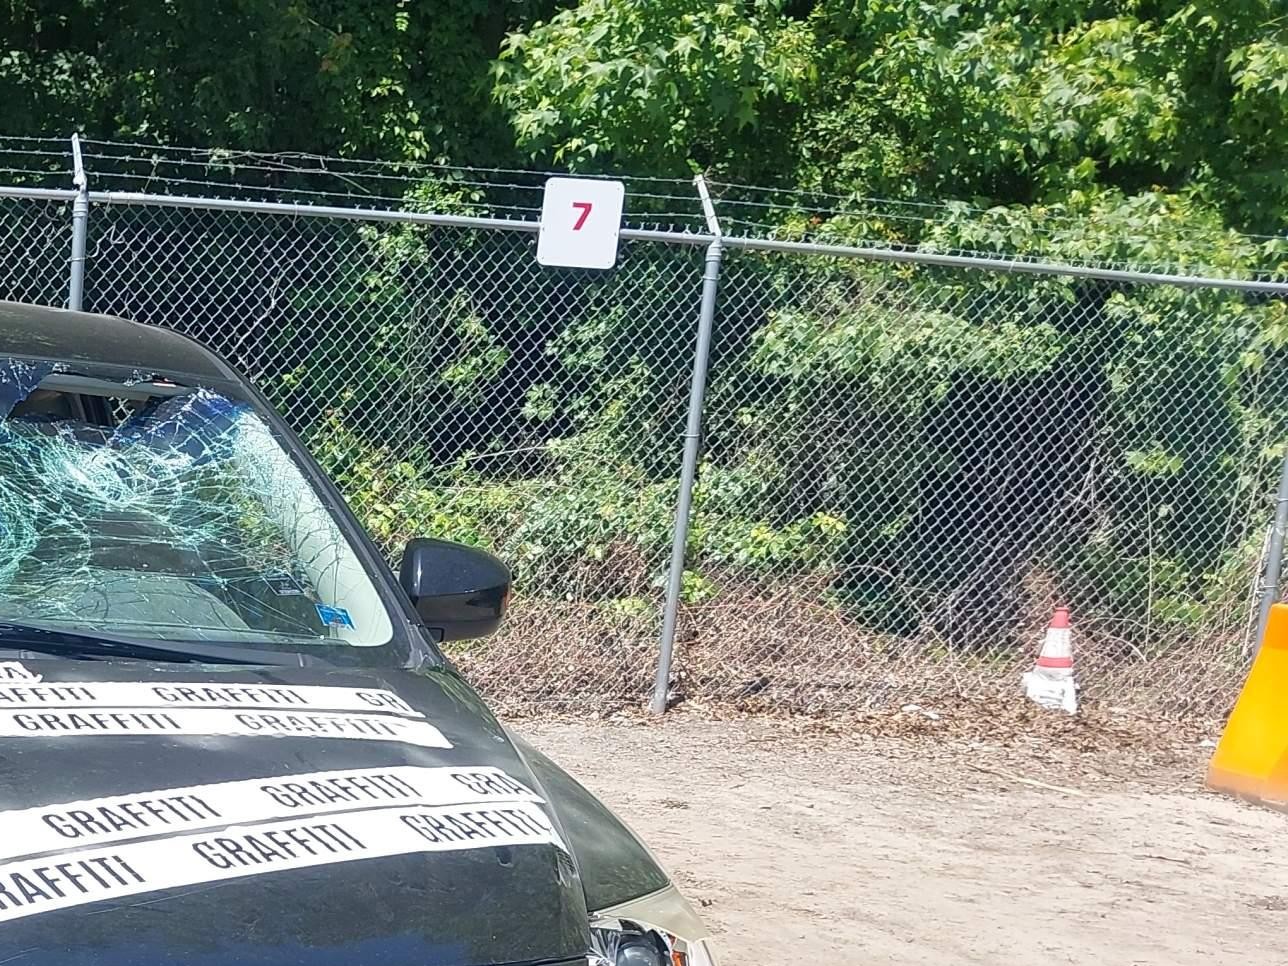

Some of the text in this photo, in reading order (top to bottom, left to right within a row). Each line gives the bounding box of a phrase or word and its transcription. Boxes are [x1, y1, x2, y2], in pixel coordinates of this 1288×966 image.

[572, 202, 592, 231] 7
[152, 687, 310, 705] GRAFFITI
[13, 713, 182, 731] GRAFFITI
[42, 794, 223, 839] GRAFFITI
[260, 773, 424, 808] GRAFFITI
[192, 823, 368, 870] GRAFFITI
